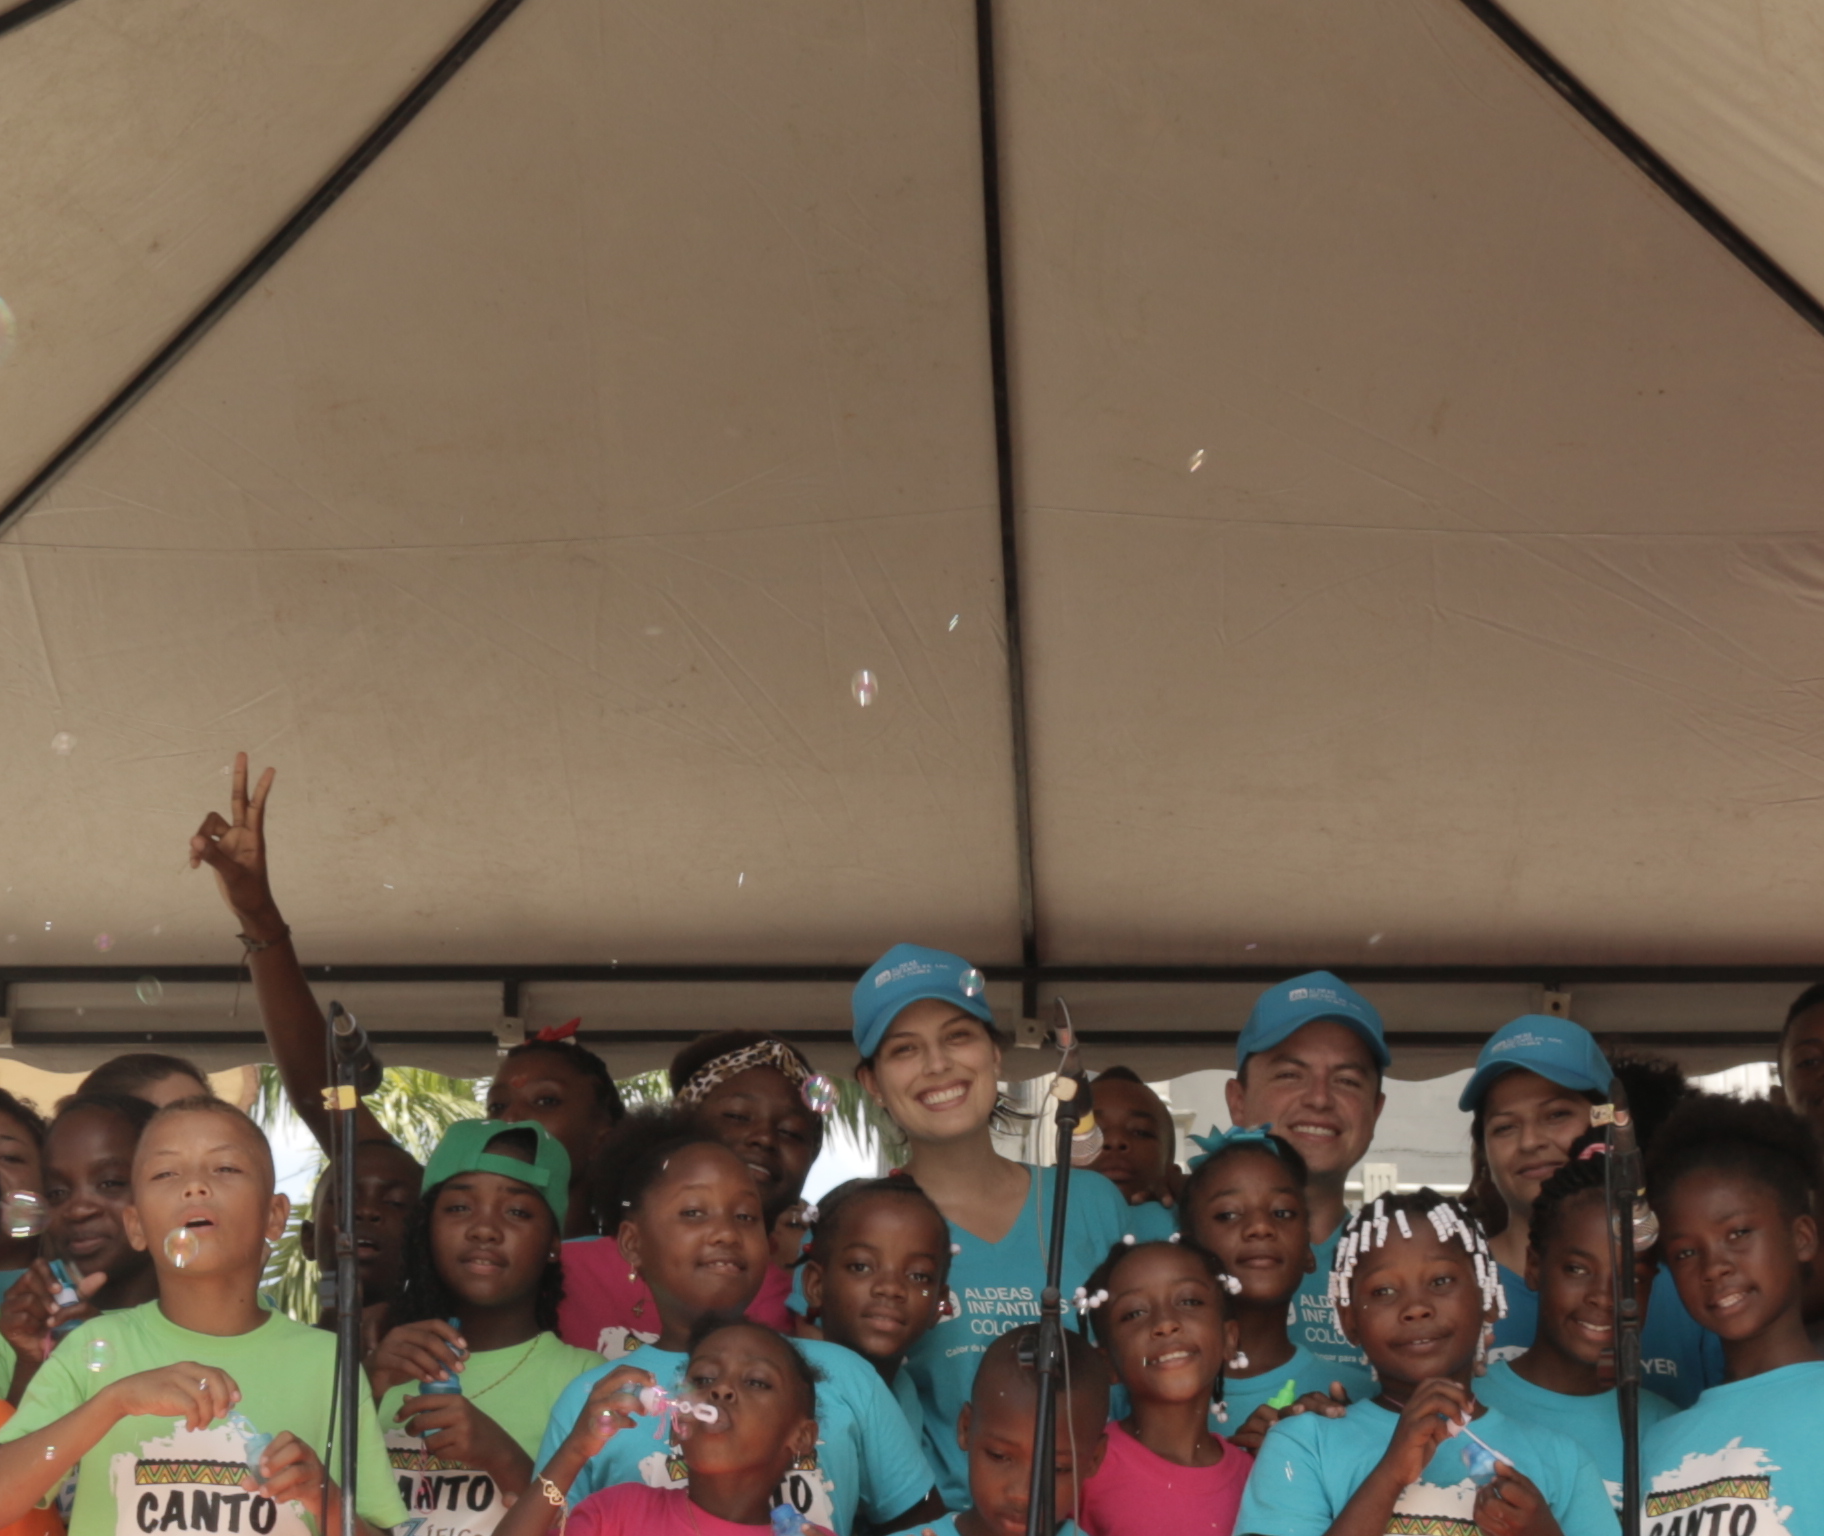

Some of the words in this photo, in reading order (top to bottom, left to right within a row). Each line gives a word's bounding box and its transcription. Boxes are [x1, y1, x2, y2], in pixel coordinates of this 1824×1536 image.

[965, 1287, 1034, 1300] ALDEAS
[967, 1298, 1069, 1316] INFANTILS
[136, 1489, 277, 1535] CANTO
